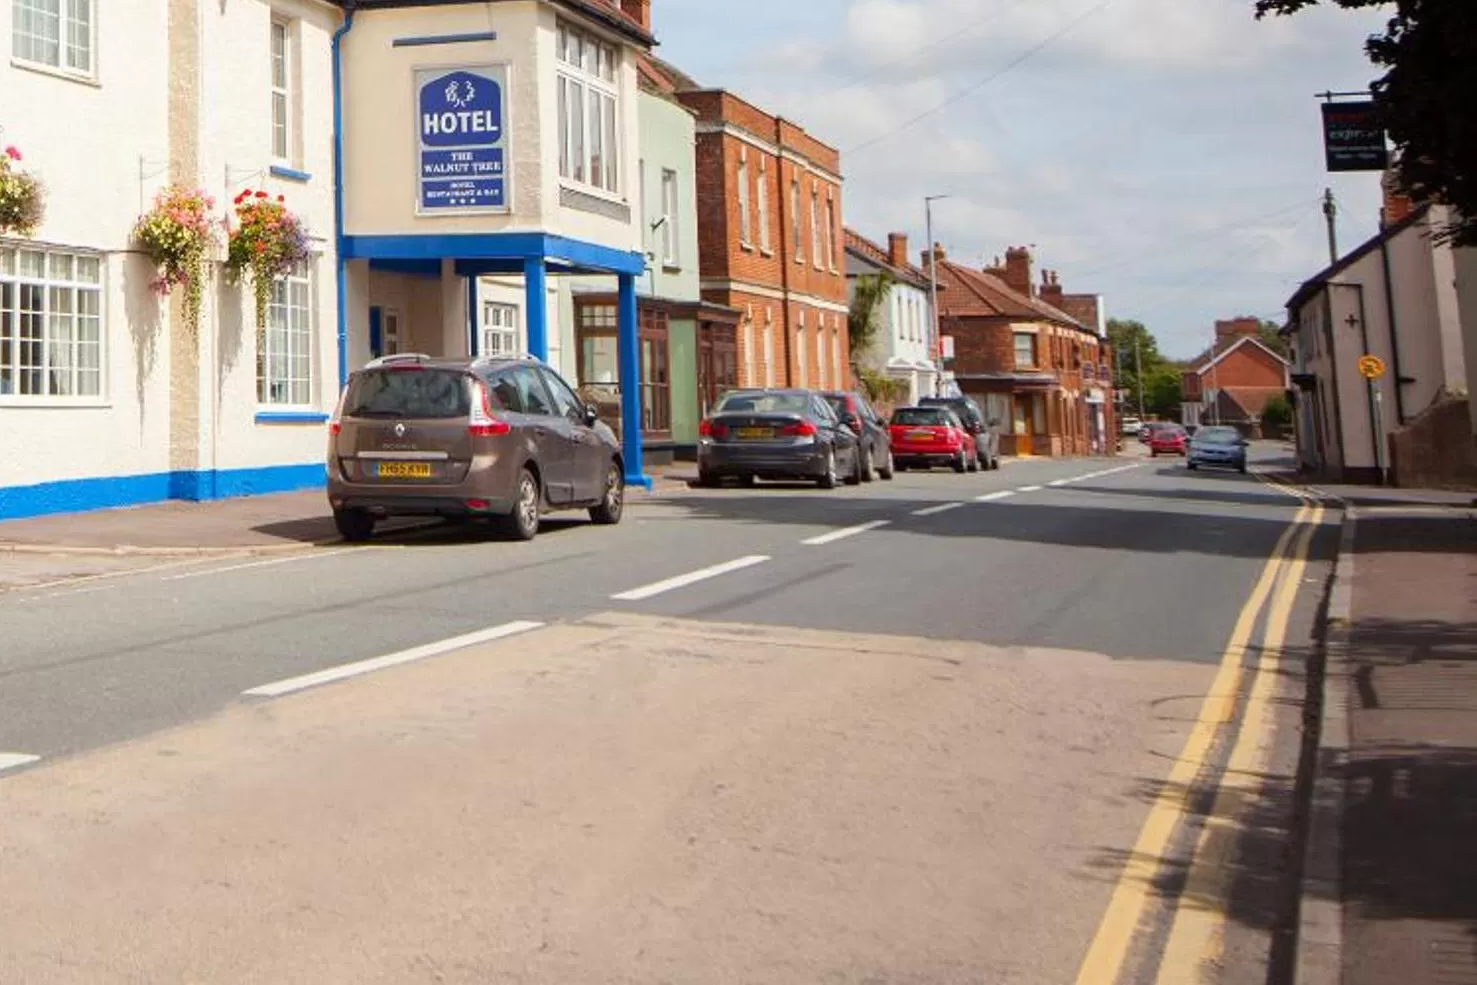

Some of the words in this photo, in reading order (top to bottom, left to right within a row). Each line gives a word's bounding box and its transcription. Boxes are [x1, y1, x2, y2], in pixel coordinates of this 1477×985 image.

[423, 110, 498, 135] HOTEL
[450, 151, 474, 162] THE
[424, 163, 470, 173] WALNUT
